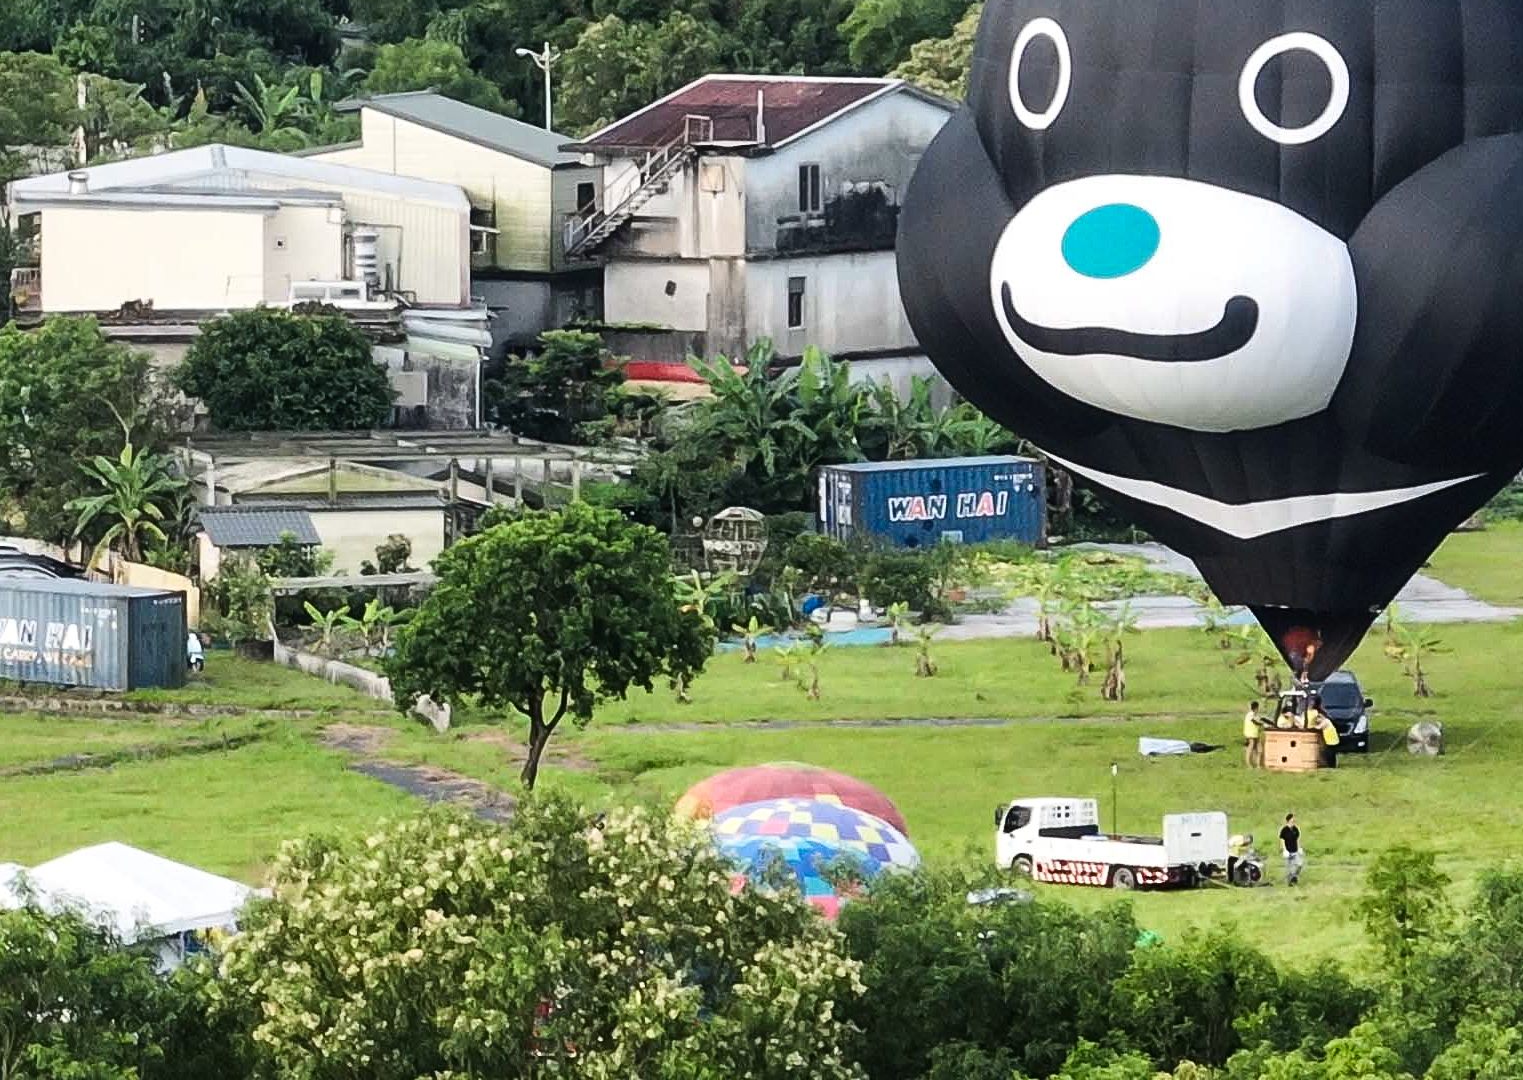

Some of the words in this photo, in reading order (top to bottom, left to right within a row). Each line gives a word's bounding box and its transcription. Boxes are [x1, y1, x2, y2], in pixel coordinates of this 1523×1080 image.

[888, 494, 948, 522] WAN
[956, 490, 1009, 519] HAI
[45, 621, 93, 651] HAI
